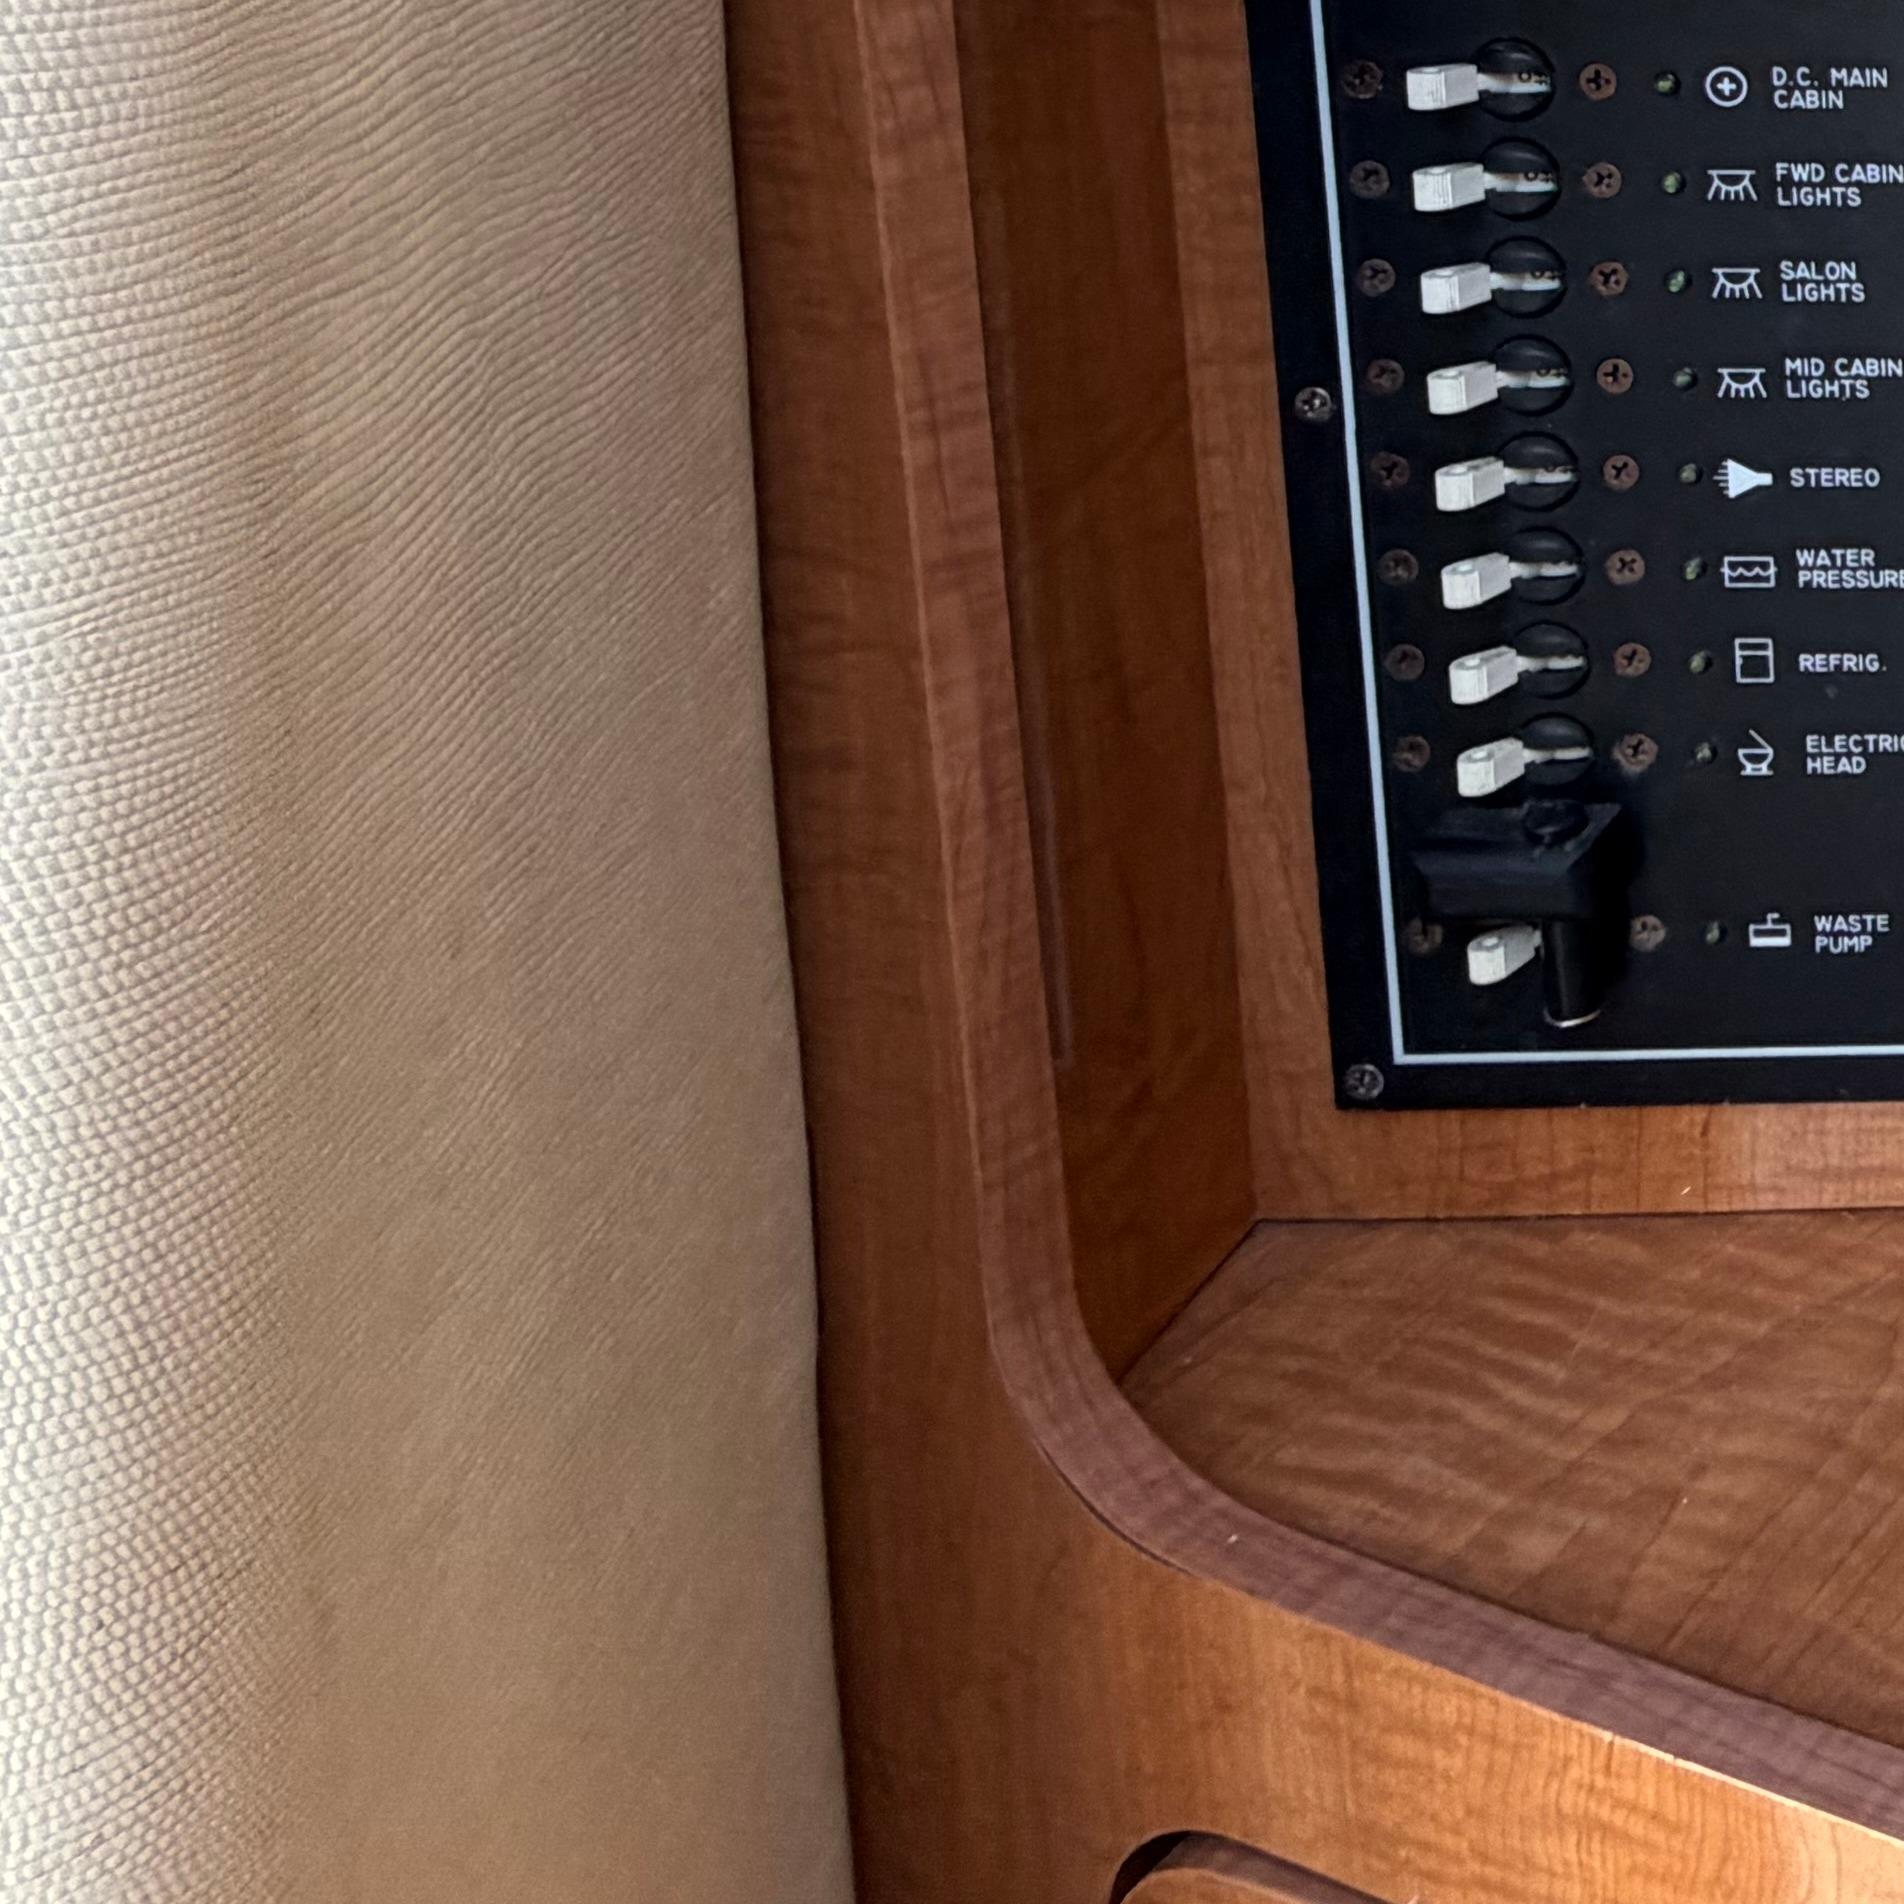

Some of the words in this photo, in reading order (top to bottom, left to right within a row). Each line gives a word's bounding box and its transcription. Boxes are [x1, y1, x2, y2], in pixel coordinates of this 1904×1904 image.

[1771, 66, 1819, 87] D.C.
[1830, 67, 1889, 88] MAIN
[1773, 89, 1844, 110] CABIN
[1775, 162, 1826, 183] FWD
[1834, 163, 1904, 184] CABIN
[1776, 186, 1862, 207] LIGHTS
[1779, 260, 1857, 281] SALON
[1780, 282, 1866, 303] LIGHTS
[1784, 357, 1826, 378] MID
[1834, 357, 1904, 378] CABIN
[1785, 378, 1871, 399] LIGHTS
[1789, 467, 1881, 488] STEREO
[1795, 548, 1876, 568] WATER
[1799, 653, 1888, 673] REFRIG.
[1806, 755, 1867, 775] HEAD
[1814, 913, 1891, 933] WASTE
[1814, 935, 1873, 954] PUMP
